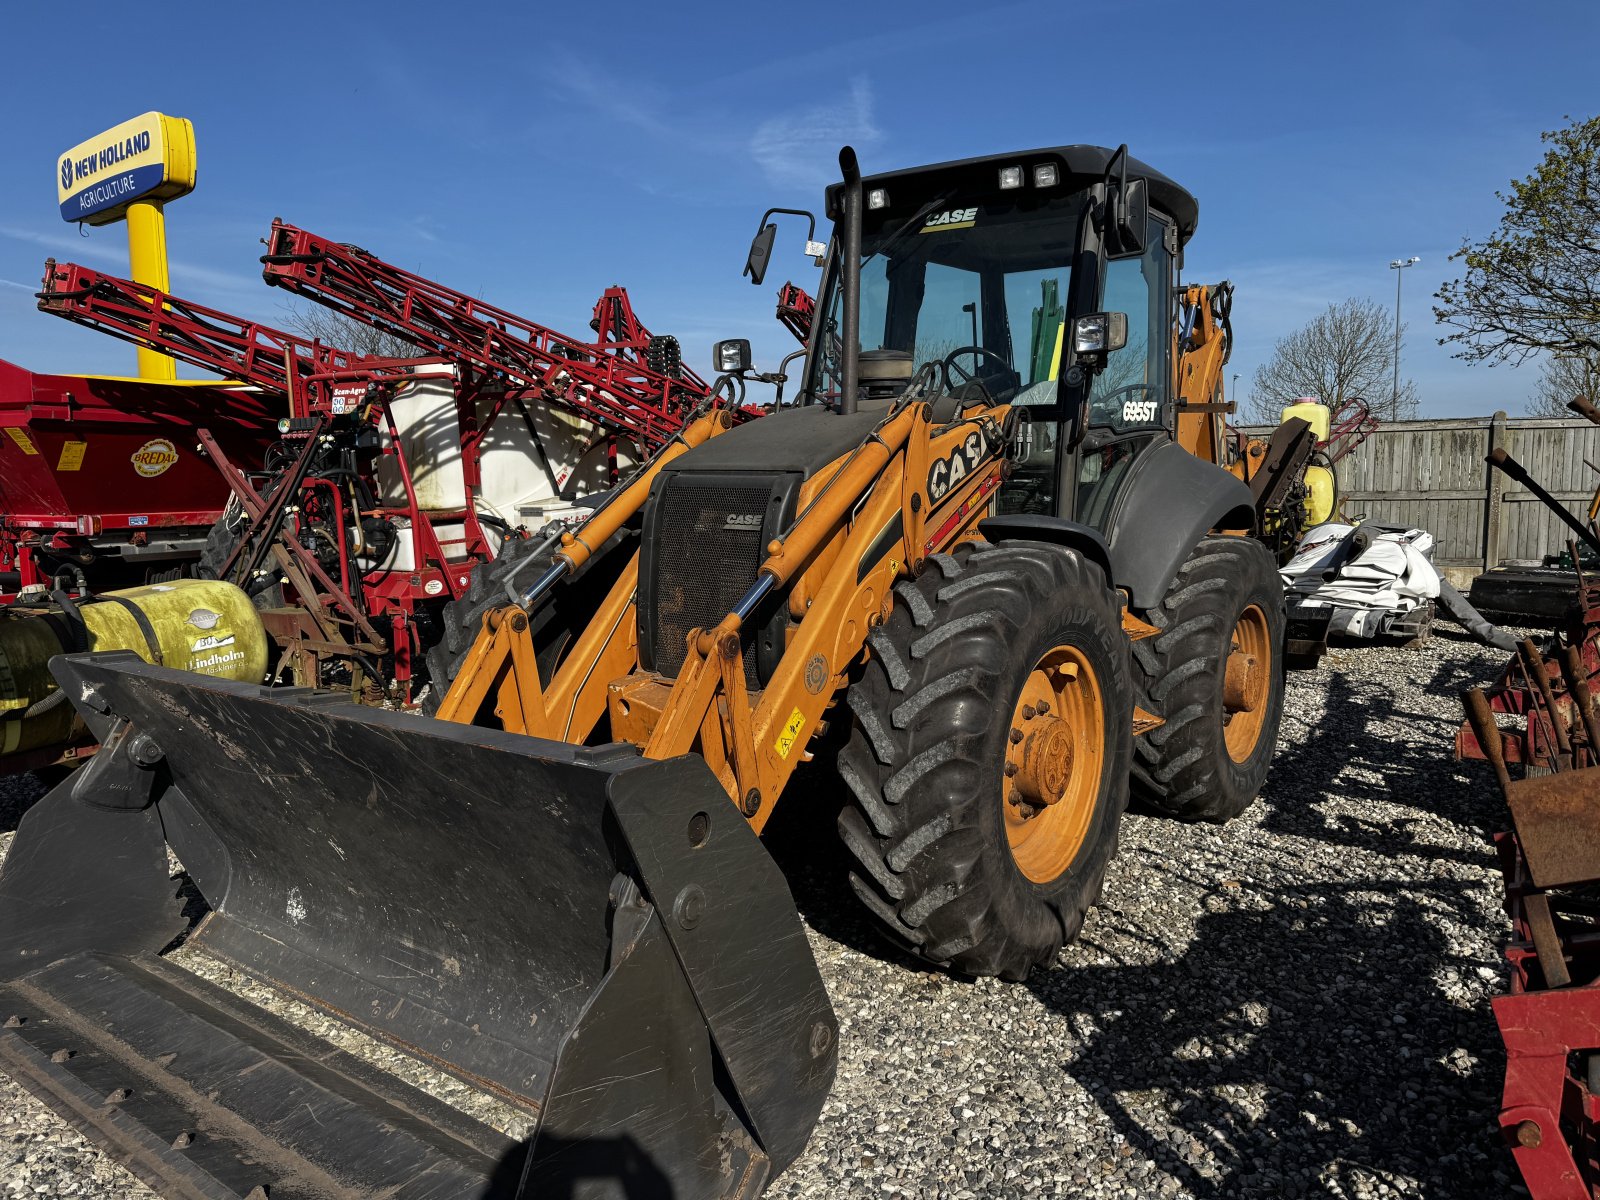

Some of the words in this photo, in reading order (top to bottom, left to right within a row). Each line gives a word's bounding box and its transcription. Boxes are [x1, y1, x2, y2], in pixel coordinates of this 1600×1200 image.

[75, 153, 97, 181] NEW
[99, 130, 150, 170] HOLLAND
[79, 174, 136, 211] AGRICULTURE
[925, 207, 978, 226] CASE
[333, 387, 366, 396] Scan-Agro
[1122, 400, 1158, 422] 695ST
[134, 451, 177, 465] BREDAL
[726, 513, 762, 526] CASE
[191, 613, 217, 623] HARDI
[1038, 606, 1124, 693] GOODYEAR
[189, 650, 245, 671] Lindholm
